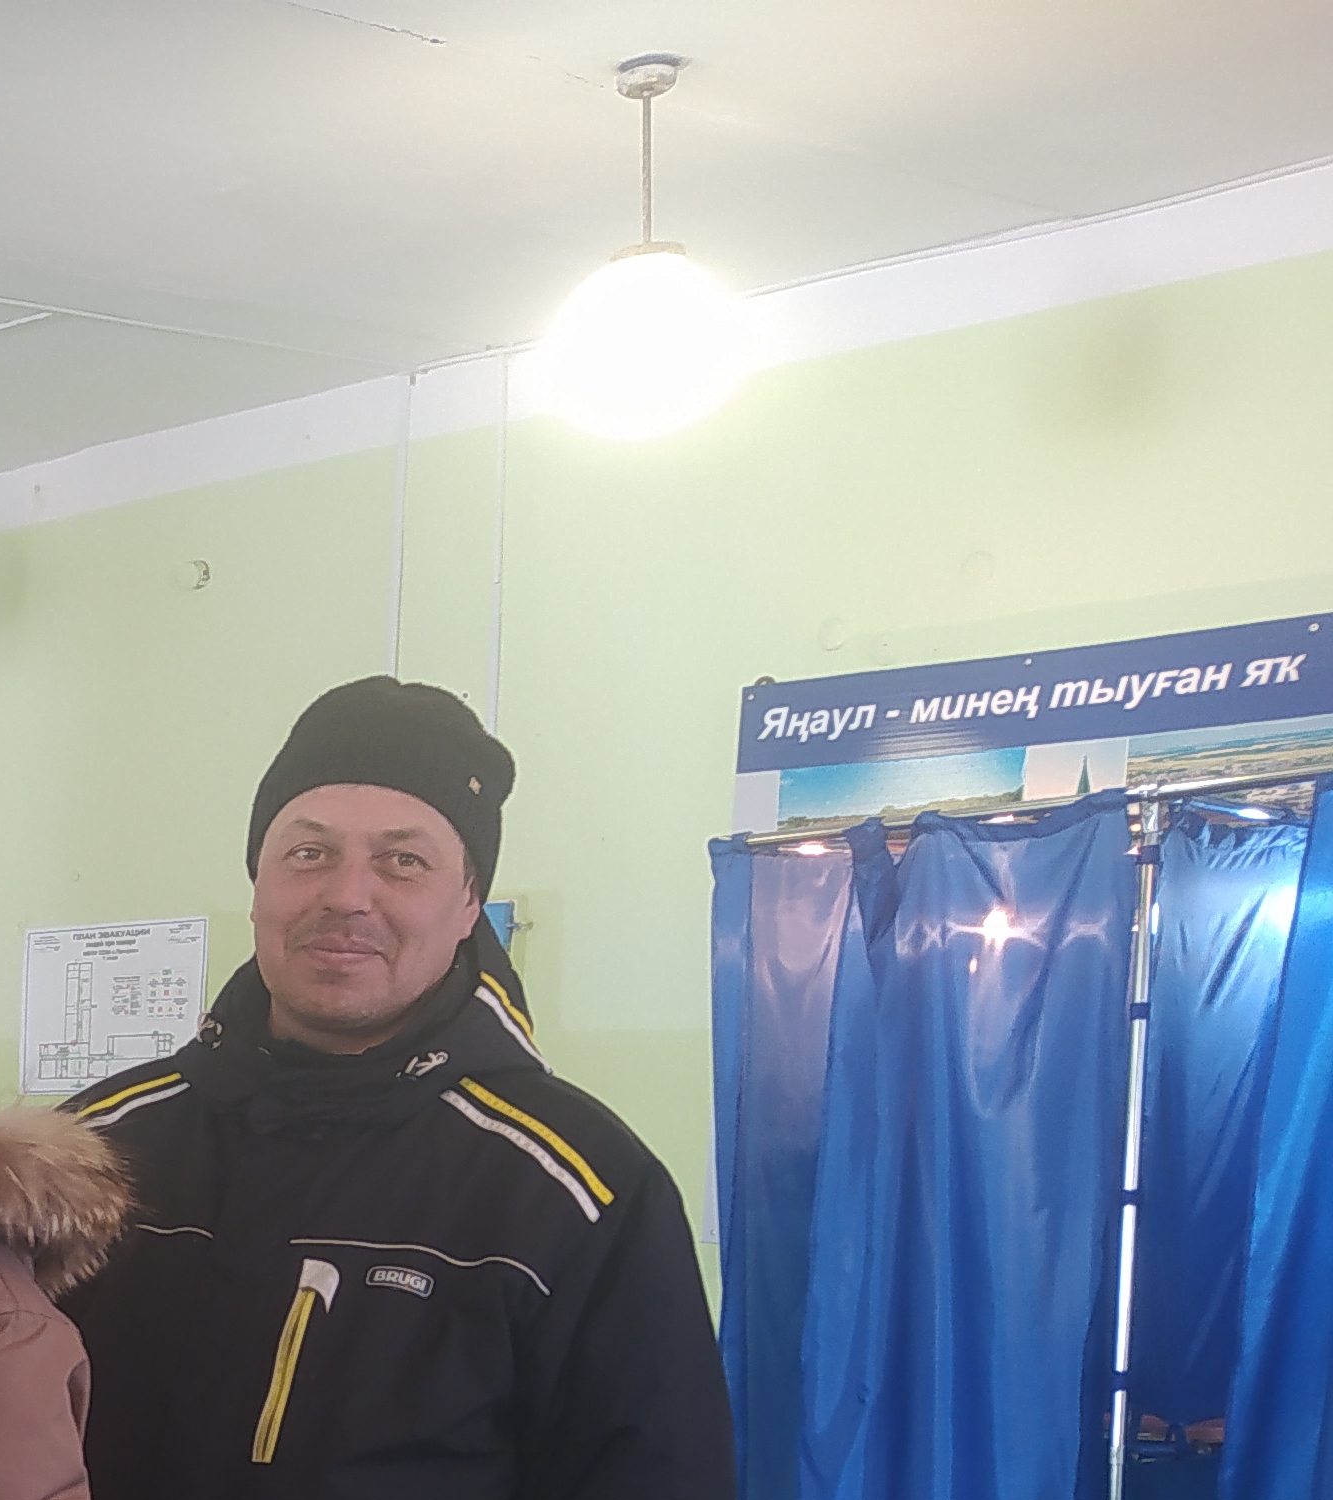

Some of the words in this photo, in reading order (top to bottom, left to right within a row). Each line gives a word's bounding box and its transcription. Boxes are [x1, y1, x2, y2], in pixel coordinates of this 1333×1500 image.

[757, 706, 876, 742] Яңаул
[910, 683, 1038, 724] минең
[1050, 661, 1233, 710] тыуған
[373, 1269, 426, 1291] BRUGI
